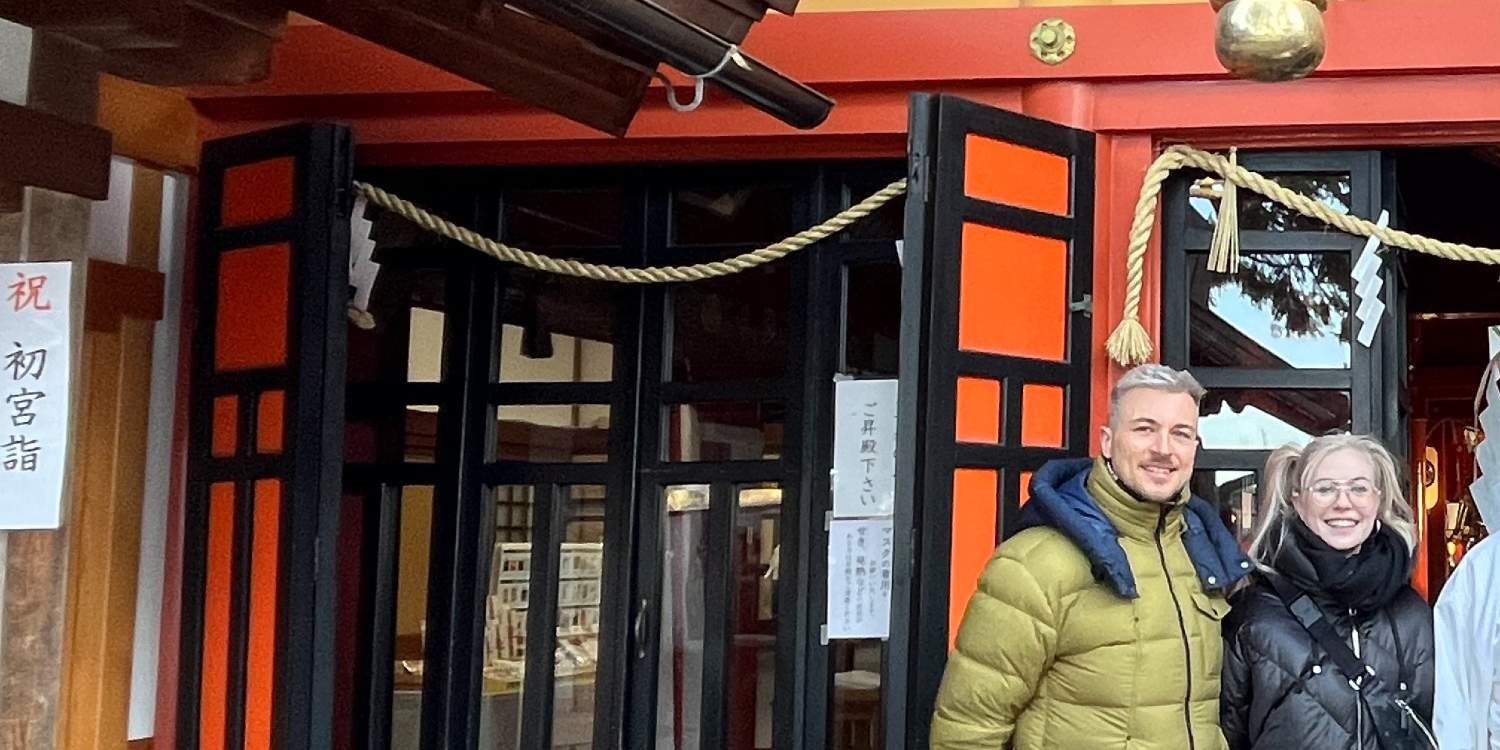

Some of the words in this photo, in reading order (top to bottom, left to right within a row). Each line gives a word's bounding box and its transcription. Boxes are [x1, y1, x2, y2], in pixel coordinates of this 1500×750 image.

[7, 272, 51, 312] 祝
[1, 341, 46, 472] 初宮詣
[860, 402, 878, 506] ご昇殿下さい
